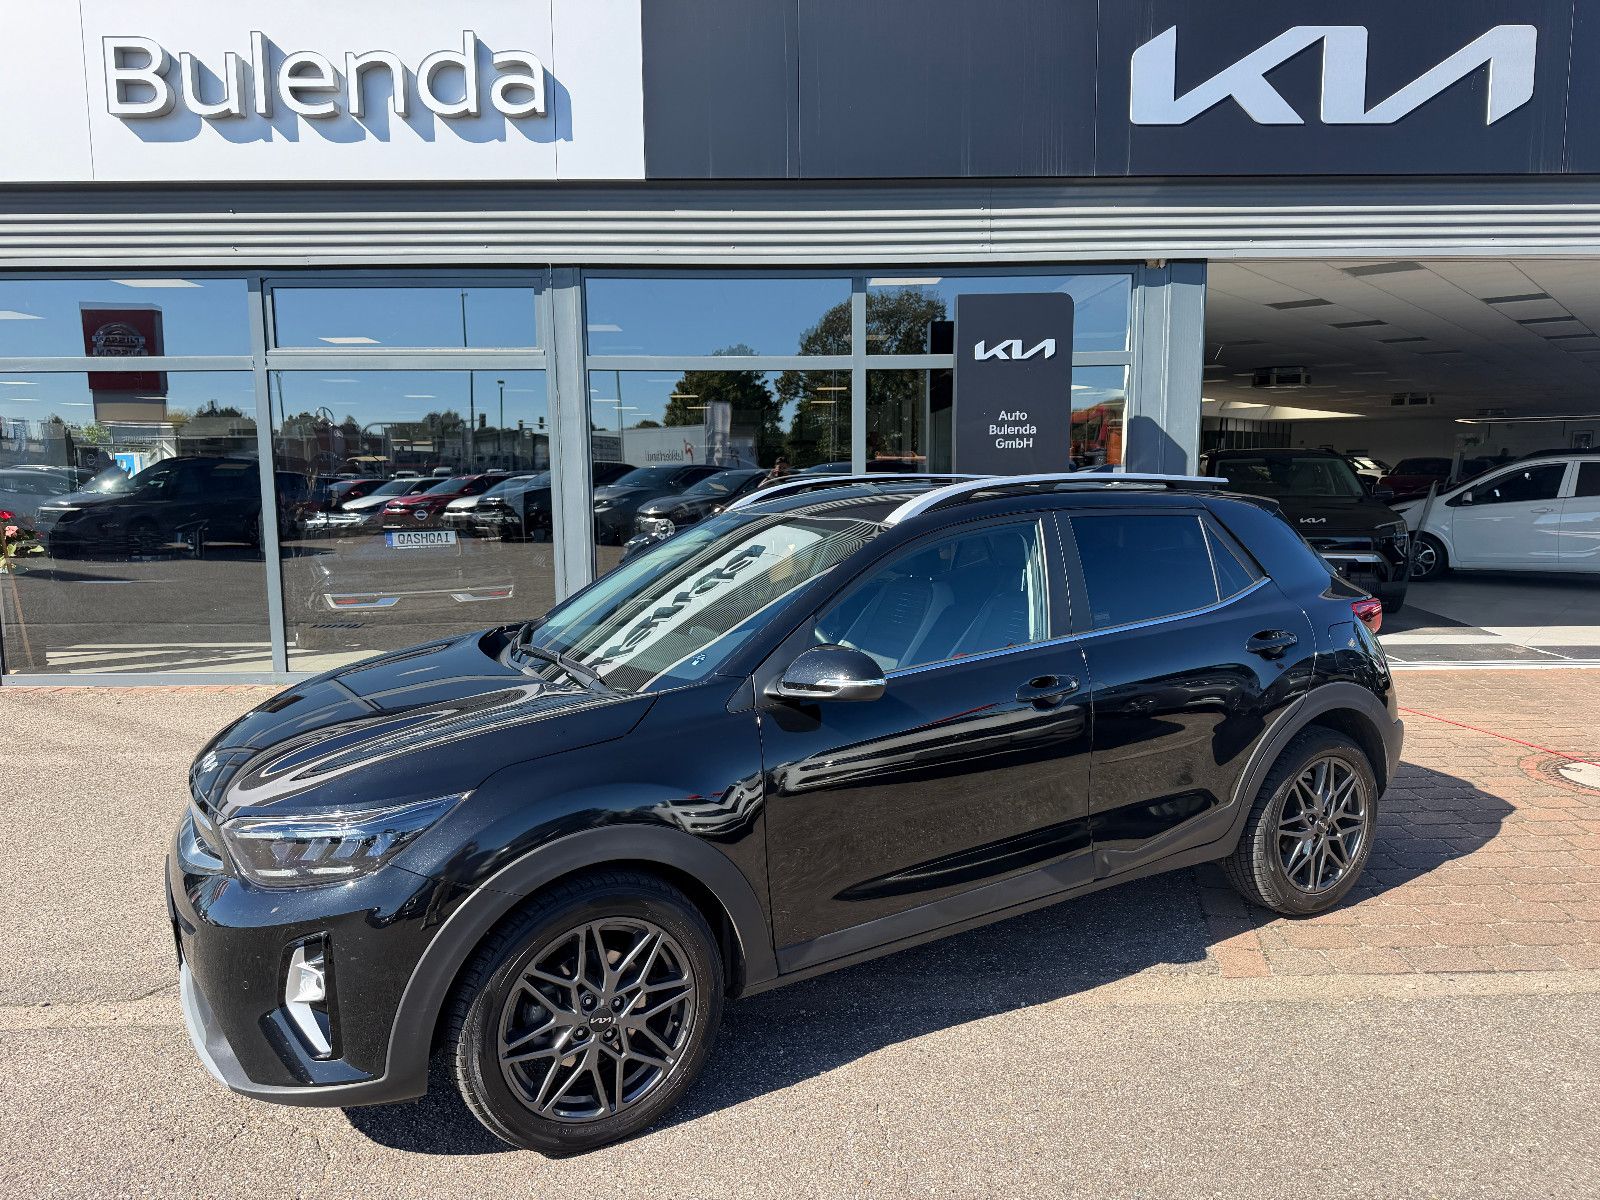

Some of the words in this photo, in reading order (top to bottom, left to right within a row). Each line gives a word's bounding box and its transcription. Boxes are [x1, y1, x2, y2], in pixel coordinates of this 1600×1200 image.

[102, 30, 549, 119] Bulenda
[1130, 25, 1537, 126] KIA
[974, 338, 1056, 360] KIA
[998, 410, 1028, 421] Auto
[989, 424, 1037, 435] Bulenda
[995, 437, 1034, 449] GmbH
[397, 532, 451, 545] QASHQAI
